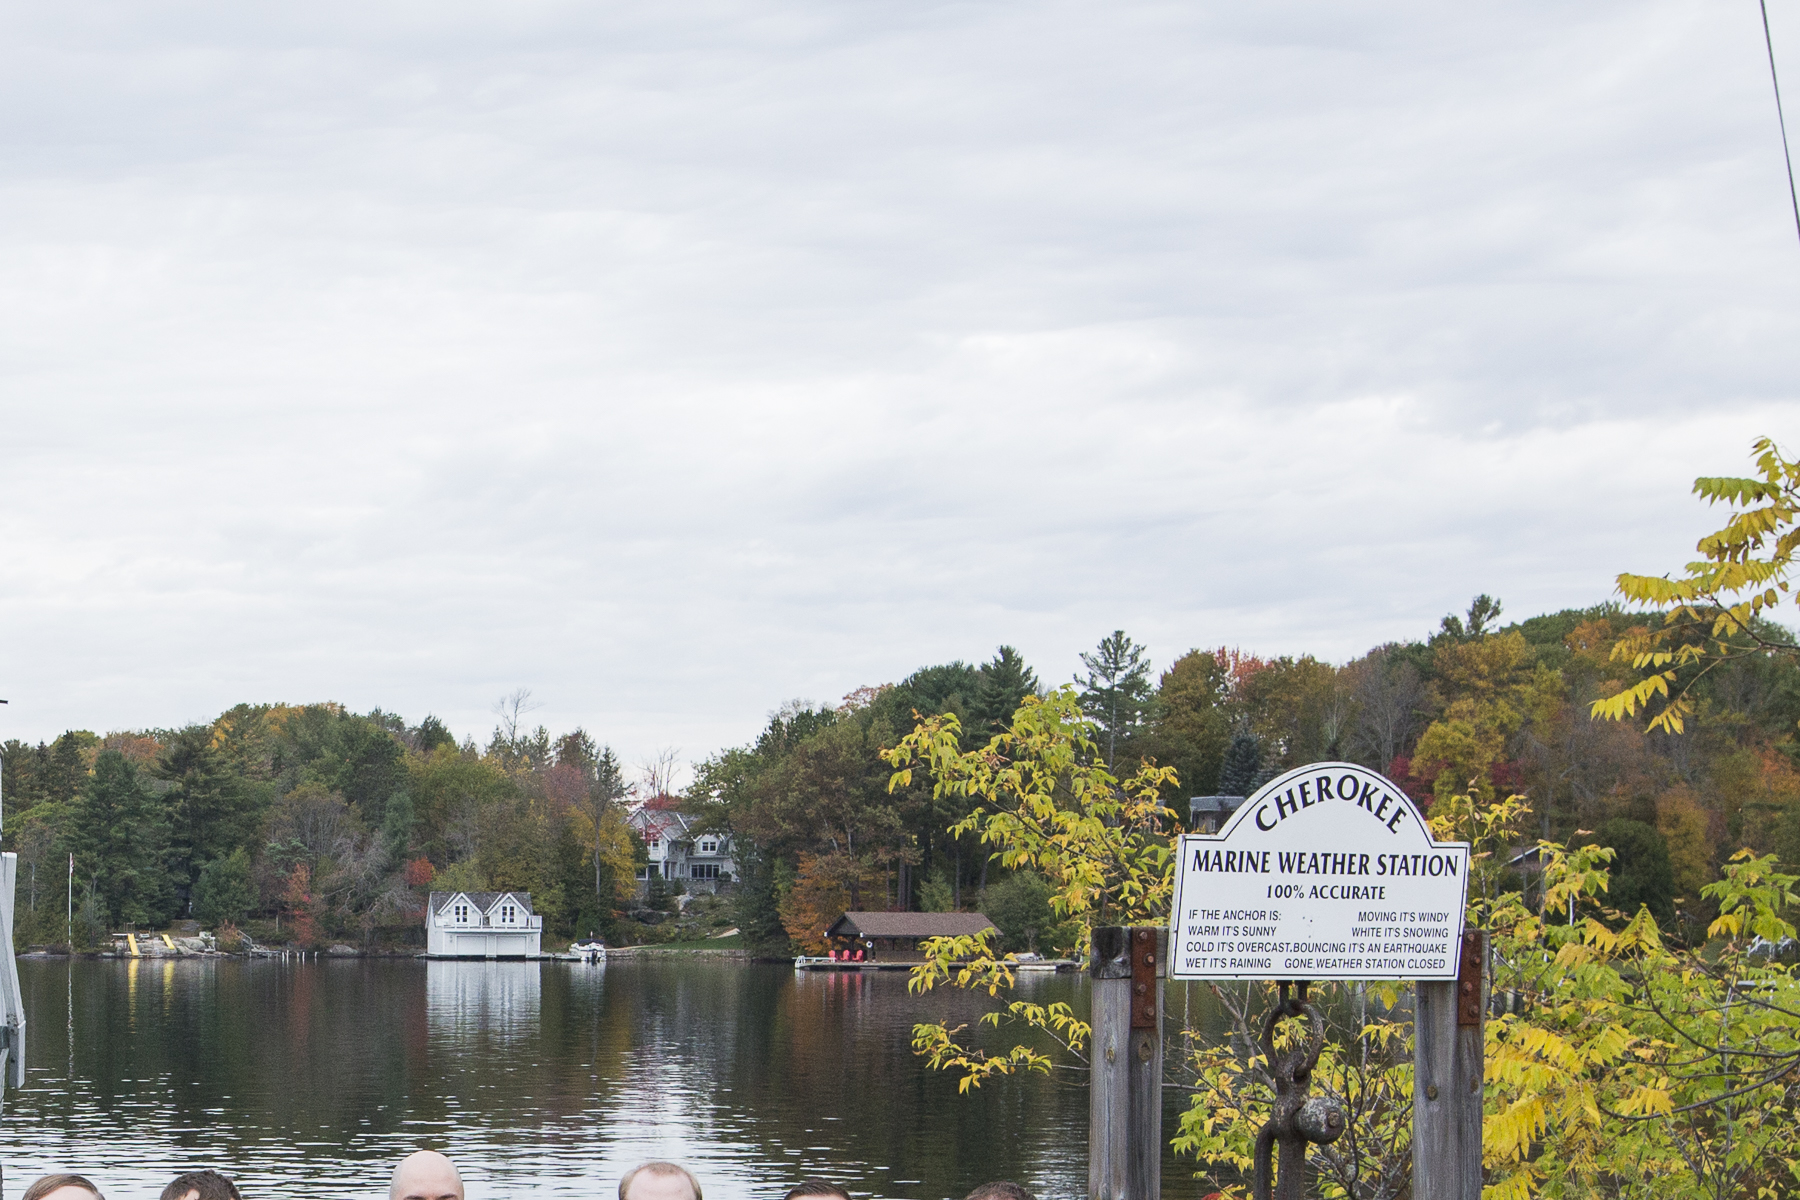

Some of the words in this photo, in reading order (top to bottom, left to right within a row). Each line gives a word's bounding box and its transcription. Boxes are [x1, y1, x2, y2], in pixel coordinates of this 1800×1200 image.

[1255, 774, 1407, 835] CHEROKEE
[1192, 849, 1271, 874] MARINE
[1278, 851, 1370, 876] WEATHER
[1376, 853, 1459, 877] STATION
[1266, 884, 1305, 899] 100%
[1308, 884, 1386, 900] ACCURATE
[1188, 909, 1198, 920] IF
[1201, 909, 1220, 920] THE
[1222, 910, 1267, 921] ANCHOR
[1269, 910, 1282, 921] IS:
[1358, 911, 1397, 922] MOVING
[1399, 912, 1416, 923] IT'S
[1418, 912, 1450, 923] WINDY
[1188, 925, 1219, 936] WARM
[1222, 926, 1240, 937] IT'S
[1242, 926, 1277, 937] SUNNY
[1351, 927, 1382, 938] WHITE
[1384, 927, 1401, 938] IT'S
[1403, 928, 1449, 939] SNOWING
[1186, 941, 1215, 952] COLD
[1217, 942, 1235, 953] IT'S
[1293, 942, 1346, 953] BOUNCING
[1348, 943, 1365, 953] IT'S
[1367, 943, 1381, 953] AN
[1383, 943, 1447, 954] EARTHQUAKE
[1185, 957, 1207, 968] WET
[1209, 958, 1227, 969] IT'S
[1229, 958, 1272, 969] RAINING
[1316, 958, 1362, 969] WEATHER
[1365, 959, 1405, 969] STATION
[1407, 959, 1446, 969] CLOSED
